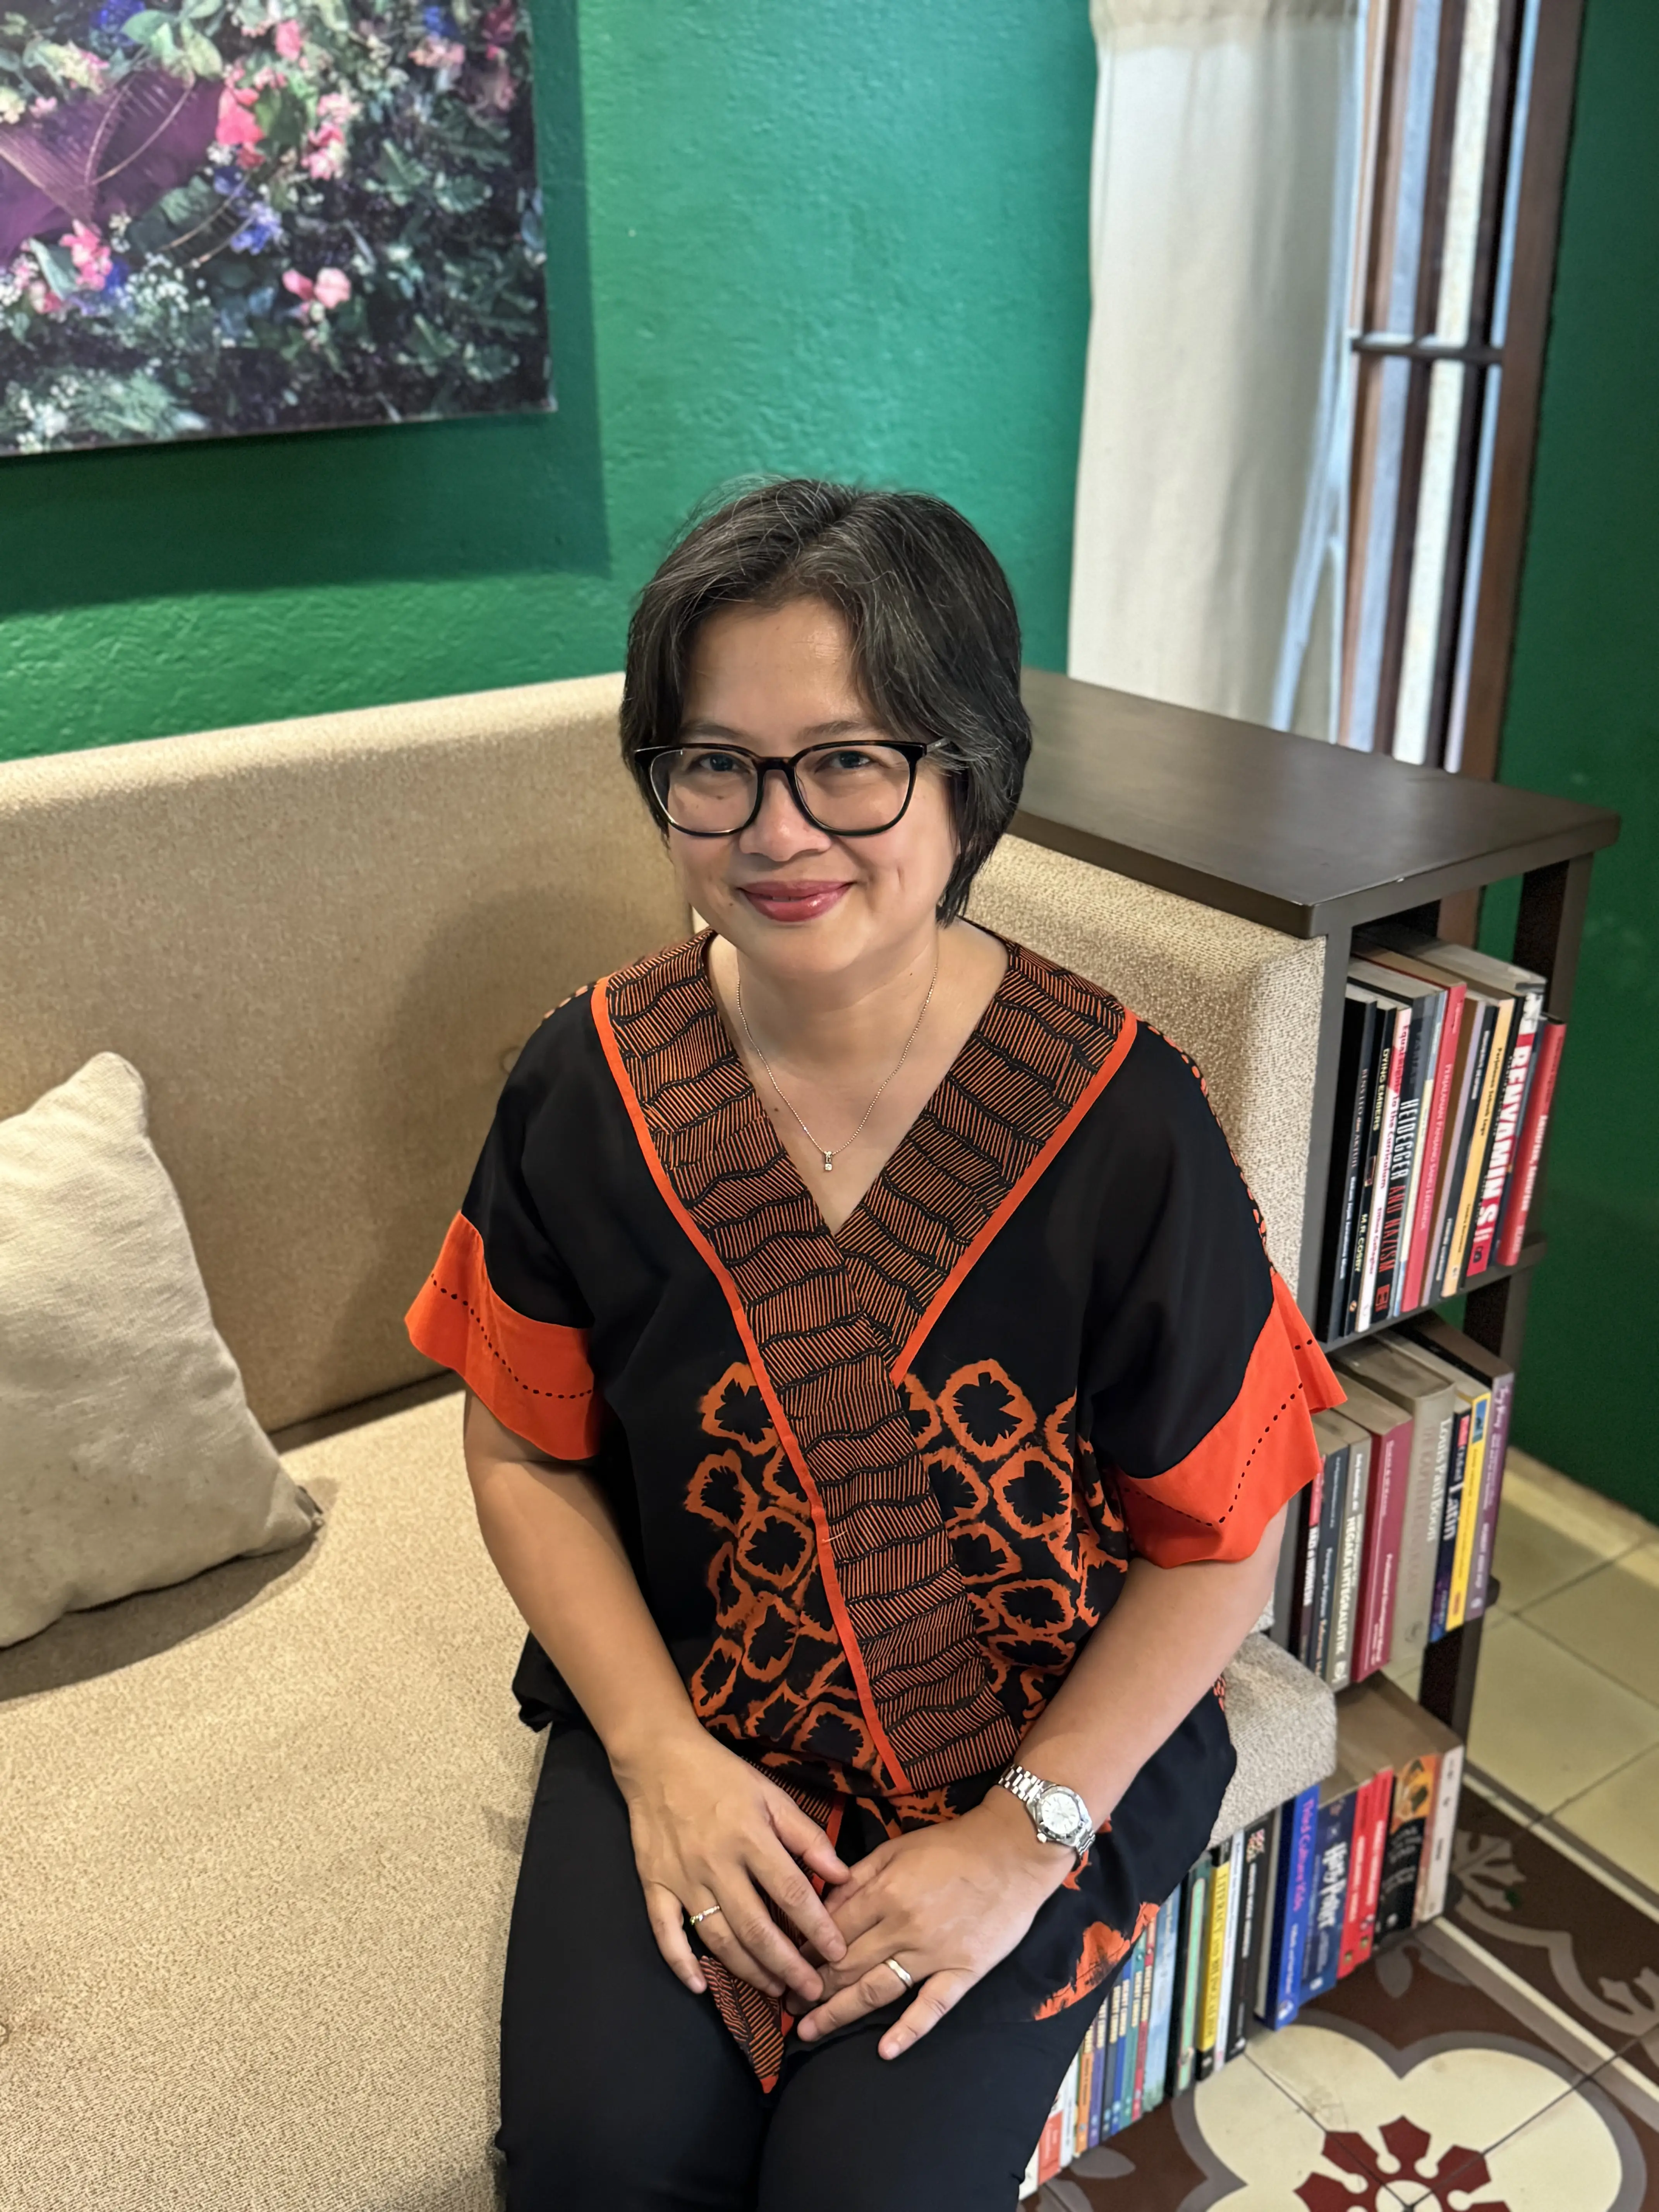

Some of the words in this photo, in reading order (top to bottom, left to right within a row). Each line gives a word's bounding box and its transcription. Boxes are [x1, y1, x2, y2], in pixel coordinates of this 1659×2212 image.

[1397, 1024, 1411, 1056] Equal
[1379, 1048, 1390, 1083] DYING
[1392, 1057, 1406, 1095] Rights
[1372, 1084, 1386, 1131] EMBERS
[1392, 1096, 1400, 1107] to
[1437, 1063, 1452, 1120] PERJALANAN
[1389, 1109, 1398, 1128] the
[1389, 1098, 1419, 1180] HEIDEGGER
[1379, 1130, 1395, 1189] Curriculum
[1386, 1184, 1406, 1214] AND
[1475, 1202, 1499, 1226] S
[1358, 1213, 1368, 1237] M.R.
[1377, 1217, 1401, 1273] NAZISM
[1353, 1237, 1365, 1273] COSBY
[1367, 1235, 1379, 1275] Gallagher
[1435, 1418, 1451, 1463] Louis
[1431, 1464, 1446, 1492] Paul
[1425, 1499, 1441, 1543] Boon
[1443, 1482, 1462, 1540] Latin
[1343, 1516, 1355, 1567] NEGARA
[1335, 1568, 1351, 1654] INTEGRALISTIK
